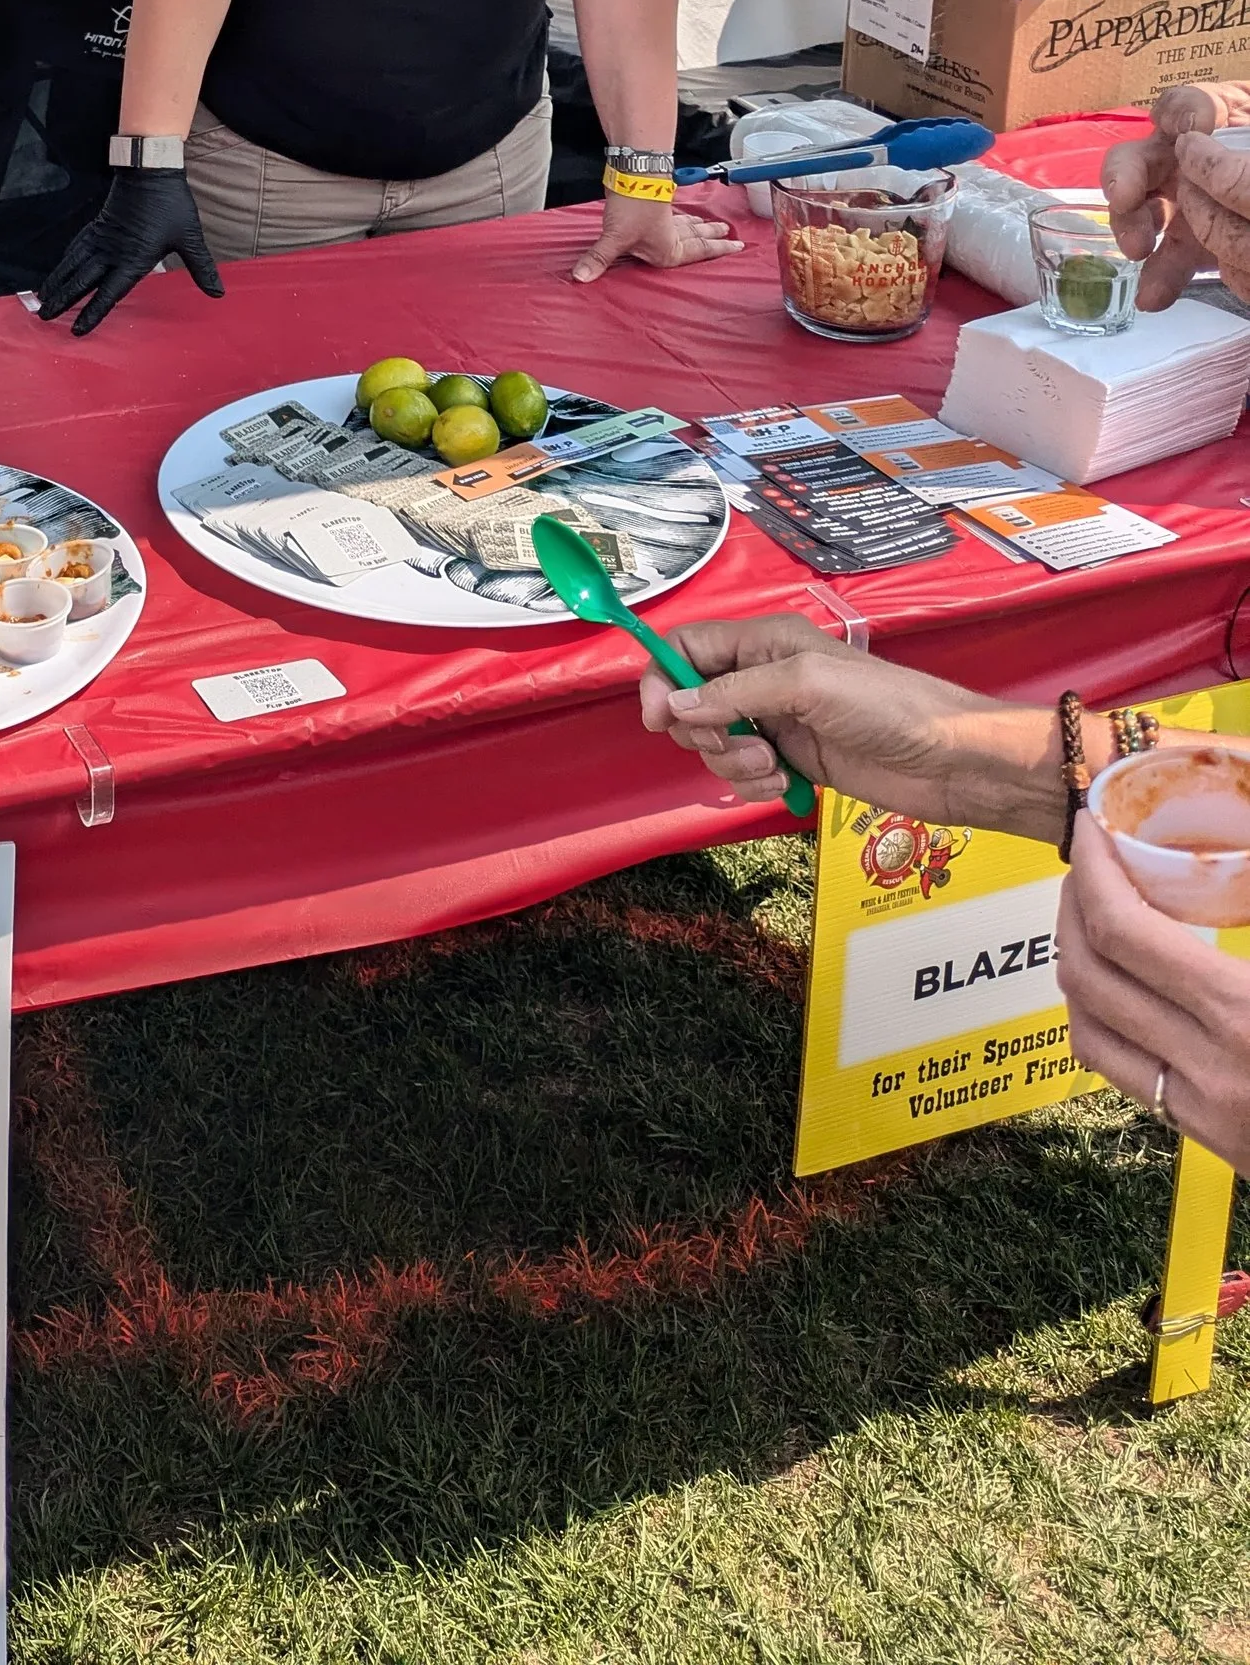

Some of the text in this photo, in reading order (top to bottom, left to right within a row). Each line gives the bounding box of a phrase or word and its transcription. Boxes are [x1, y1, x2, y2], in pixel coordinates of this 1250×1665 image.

[1157, 36, 1250, 65] THE FINE AR
[1150, 84, 1178, 94] Den
[234, 418, 271, 439] BLAZESTOP
[291, 448, 327, 471] BLAZESTOP
[329, 458, 366, 480] BLAZESTOP
[851, 811, 871, 835] BIG
[890, 815, 905, 824] FIRE
[883, 893, 898, 903] ARTS
[897, 886, 921, 899] FESTIVAL
[871, 1023, 1069, 1098] for their Sponsor
[908, 1055, 1091, 1119] Volunteer Fire
